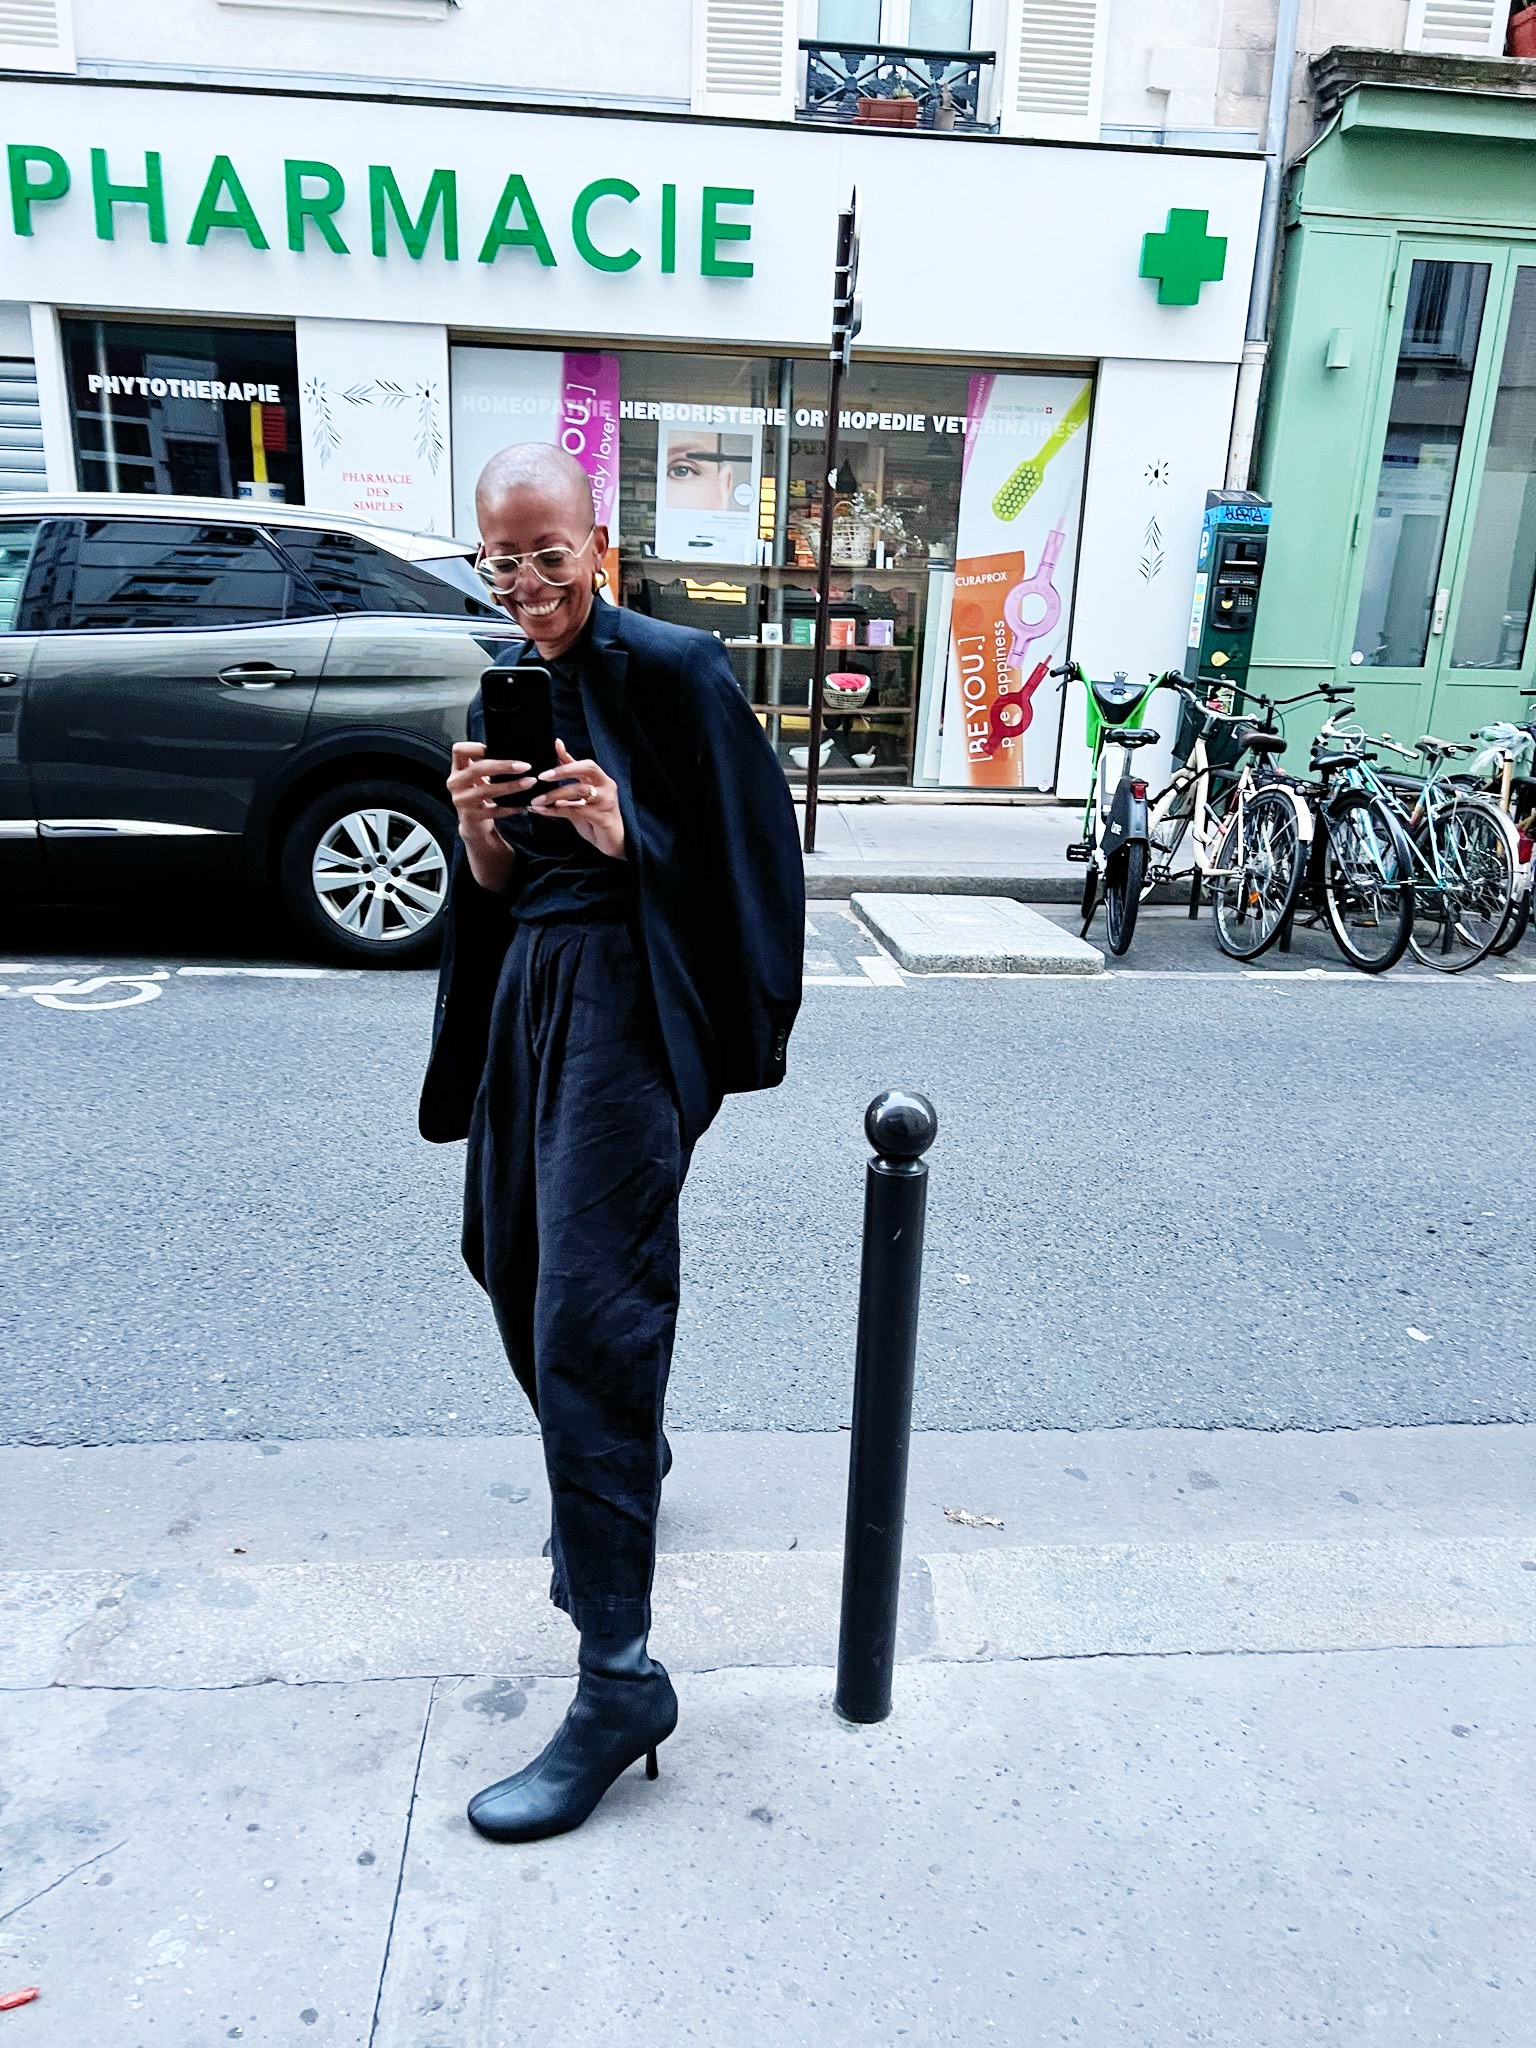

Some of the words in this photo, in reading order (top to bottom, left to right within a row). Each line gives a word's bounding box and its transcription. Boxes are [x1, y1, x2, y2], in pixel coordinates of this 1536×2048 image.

[5, 143, 756, 279] PHARMACIE
[87, 374, 281, 403] PHYTOTHERAPIE
[560, 382, 598, 456] OU.]
[592, 412, 617, 460] lover
[619, 400, 787, 426] HERBORISTERIE
[794, 407, 926, 433] ORHOPEDIE
[931, 414, 1080, 440] VETERINAIRES
[342, 473, 413, 485] PHARMACIE
[366, 487, 389, 497] DES
[353, 500, 403, 512] SIMPLES
[954, 571, 1007, 587] CURAPROX
[957, 634, 988, 719] YOU.]
[993, 620, 1012, 696] appiness
